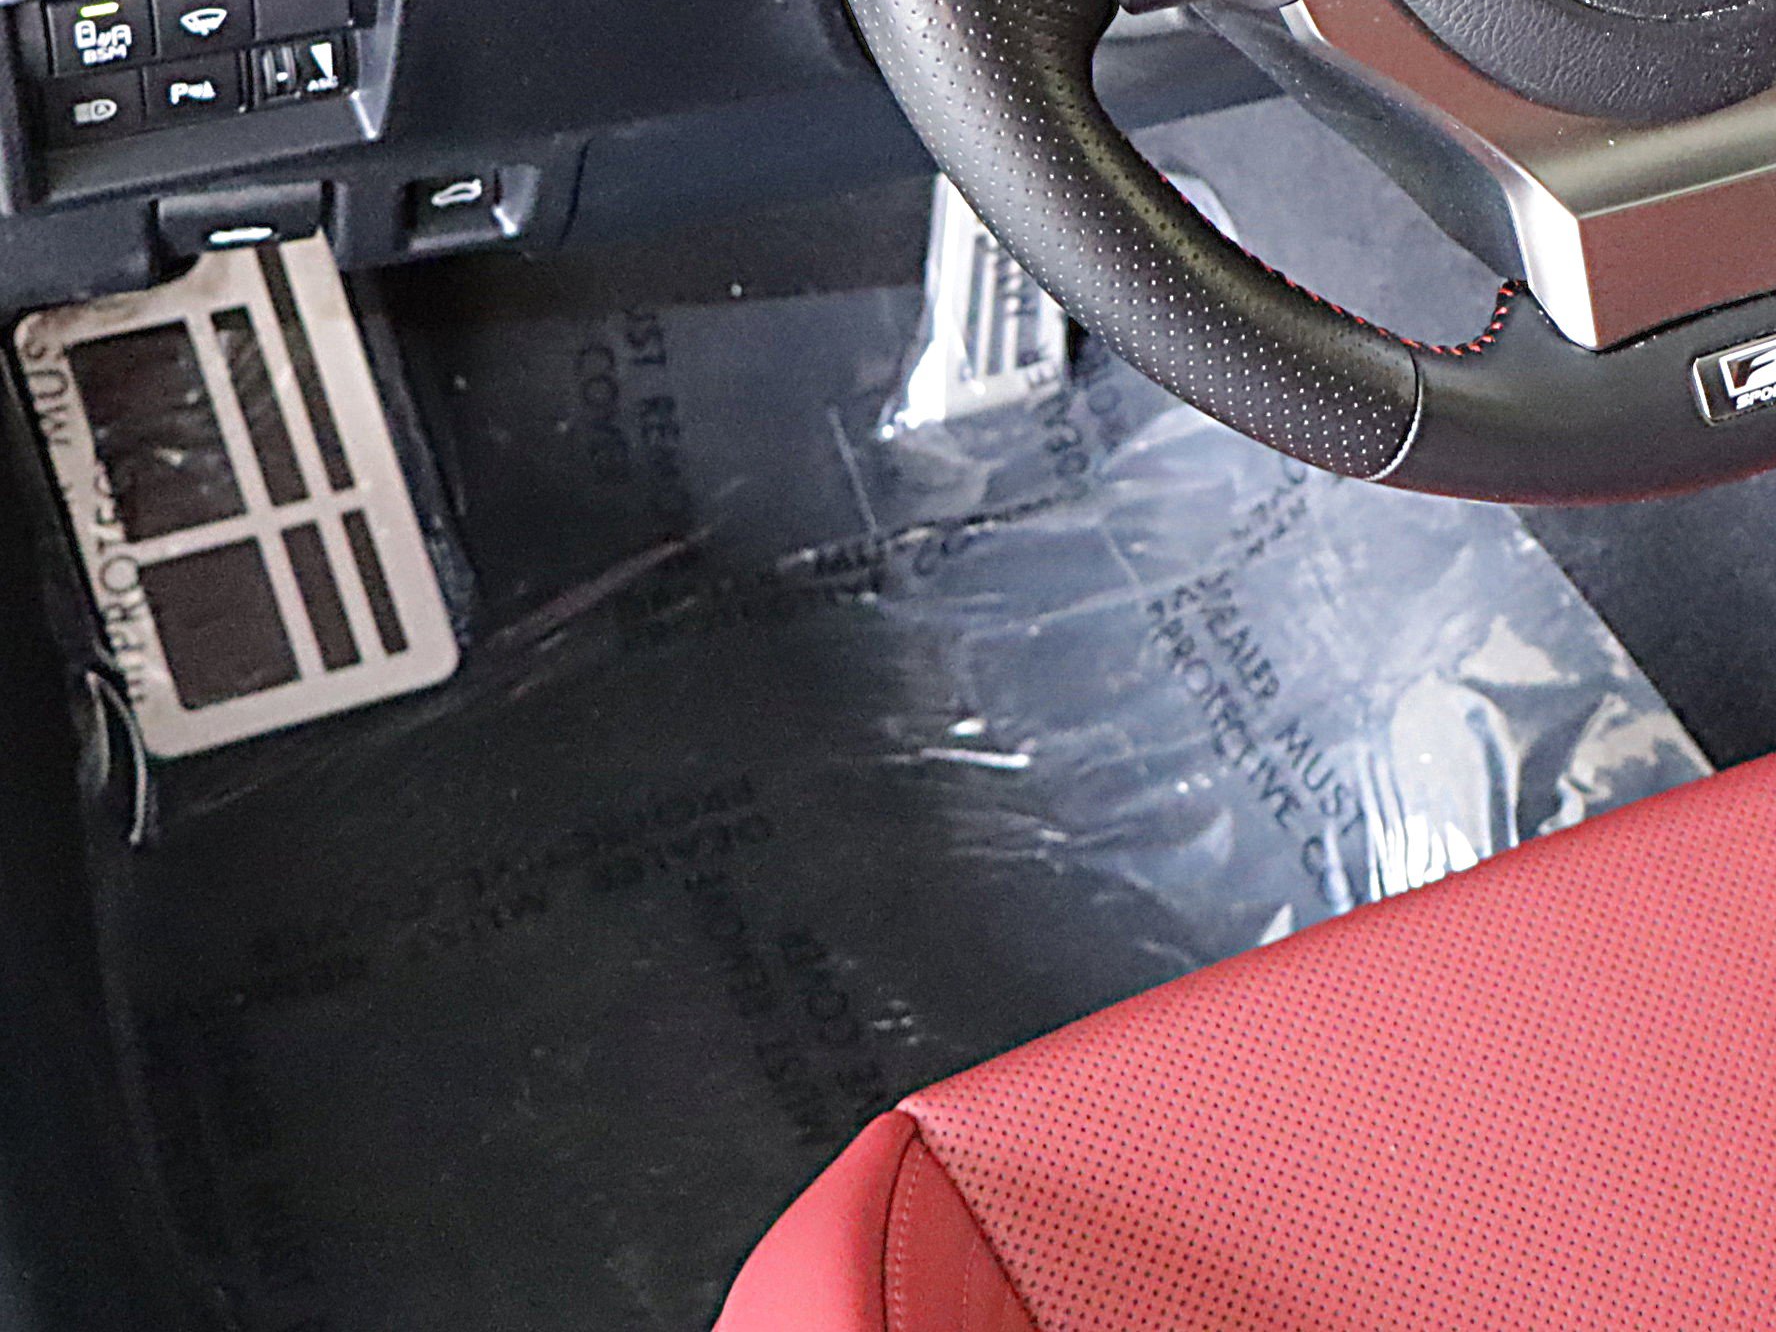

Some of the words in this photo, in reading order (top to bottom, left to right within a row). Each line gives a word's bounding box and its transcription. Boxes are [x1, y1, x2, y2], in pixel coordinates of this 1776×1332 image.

[83, 43, 128, 67] BSM
[1150, 616, 1302, 831] PROTECTIVE
[1274, 720, 1366, 838] MUST
